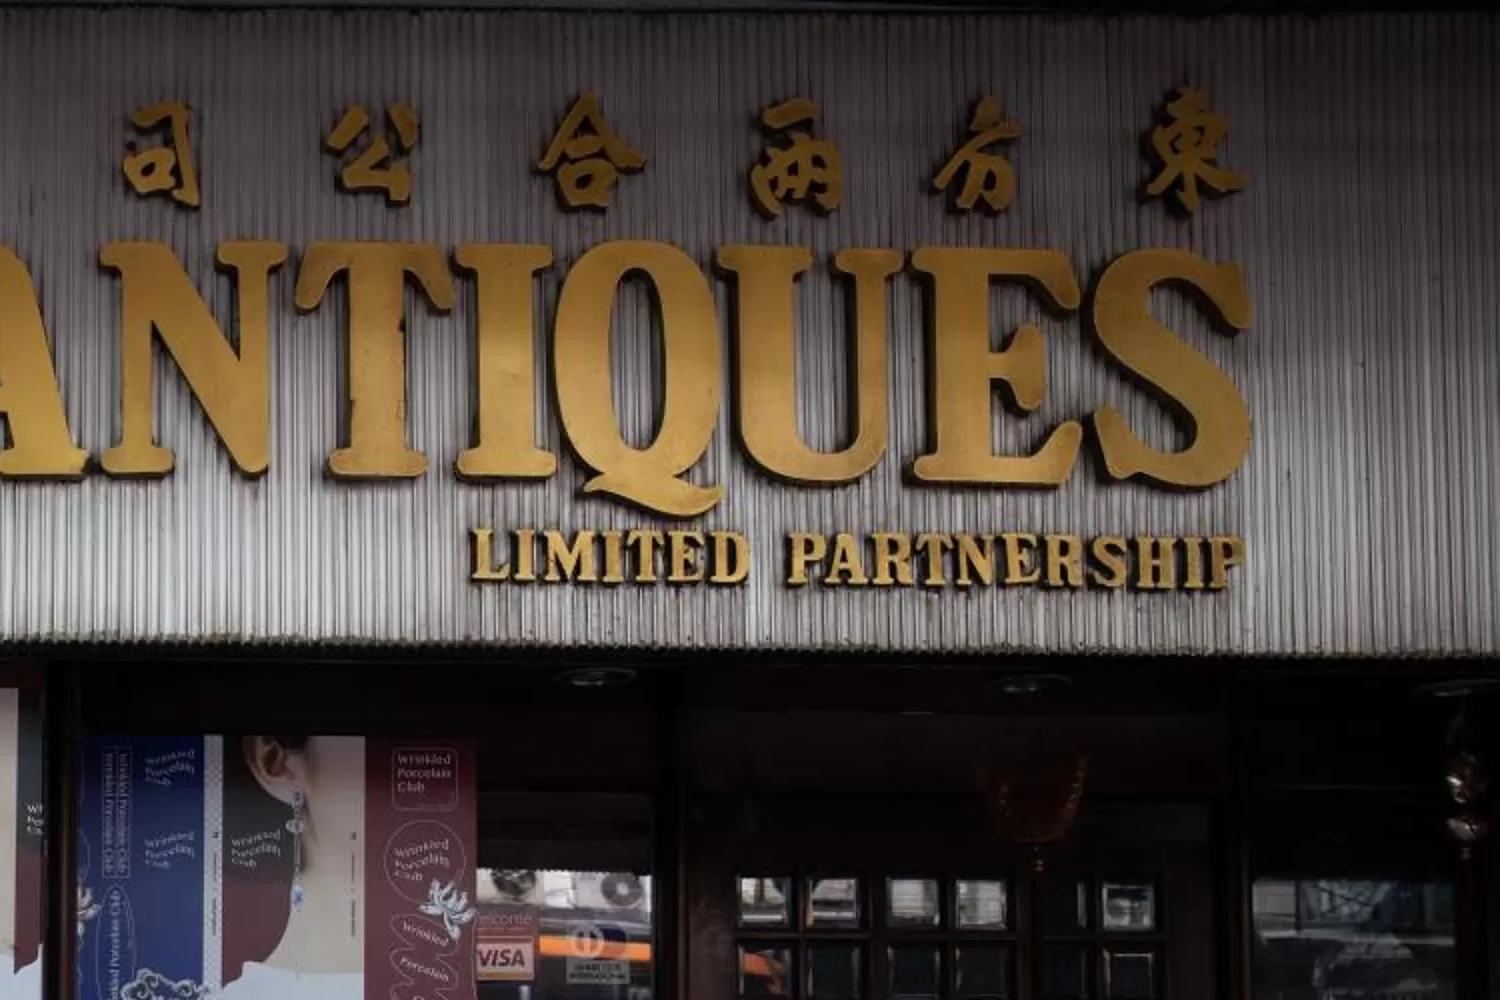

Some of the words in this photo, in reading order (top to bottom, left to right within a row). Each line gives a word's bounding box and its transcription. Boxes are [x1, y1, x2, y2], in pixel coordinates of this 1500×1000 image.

[470, 528, 750, 585] LIMITED
[787, 532, 1245, 590] PARTNERSHIP
[397, 753, 452, 766] Wrinkled
[397, 767, 452, 779] Porcelain
[397, 780, 426, 793] Club
[394, 839, 449, 859] Wrinkled
[394, 852, 449, 871] Porcelain
[402, 919, 449, 948] Wrinkled
[478, 948, 526, 968] VISA
